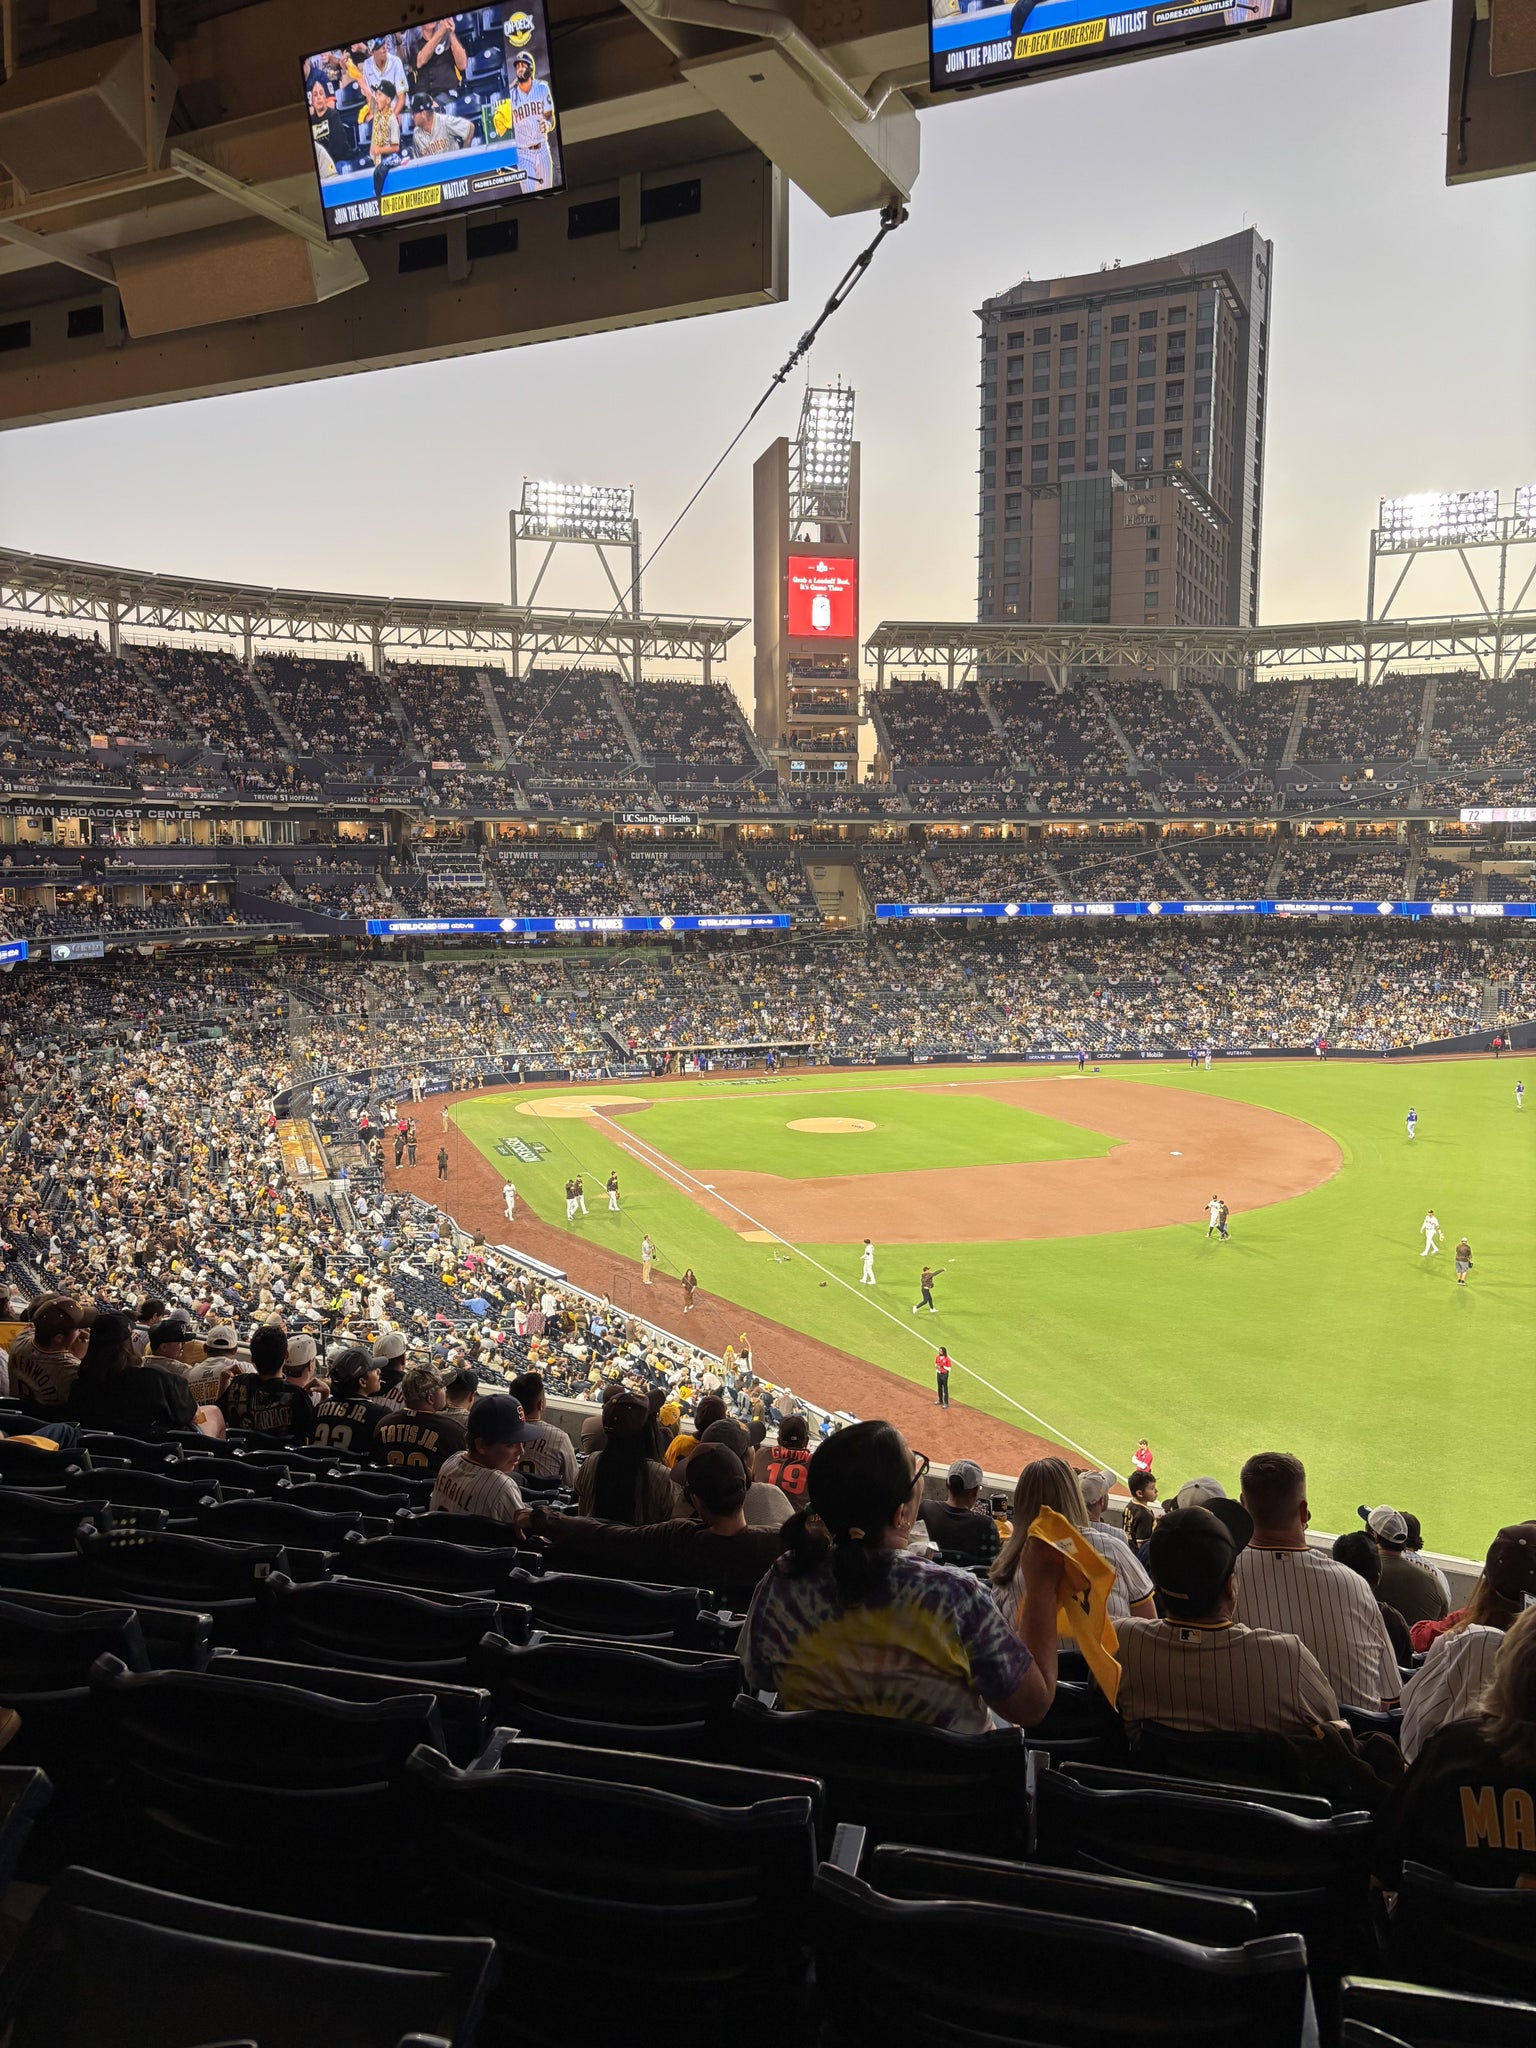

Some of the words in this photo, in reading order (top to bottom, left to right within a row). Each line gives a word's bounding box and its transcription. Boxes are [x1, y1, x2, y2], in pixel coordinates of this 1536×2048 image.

[504, 15, 534, 35] ON-DECK
[1108, 11, 1148, 38] WAITLIST
[1017, 32, 1050, 57] ON-DECK
[1051, 22, 1104, 50] MEMBERSHIP
[945, 52, 965, 73] JOIN
[966, 47, 981, 69] THE
[982, 41, 1012, 66] PADRES
[405, 190, 440, 209] MEMBERSHIP
[442, 180, 469, 200] WAITLIST
[334, 207, 348, 225] JOIN
[347, 205, 360, 223] THE
[359, 201, 380, 219] PADRES
[166, 791, 187, 799] RANDY
[199, 792, 219, 800] JONES
[60, 808, 142, 818] BROADCAST
[147, 809, 201, 819] CENTER
[622, 813, 634, 823] UC
[634, 813, 648, 823] San
[648, 814, 668, 824] Diego
[668, 814, 691, 823] Health
[499, 851, 539, 859] CUTWATER
[631, 852, 668, 860] CUTWATER
[1052, 904, 1072, 914] CUBS
[1086, 904, 1114, 914] PADRES
[1431, 904, 1454, 915] CUBS
[1470, 904, 1504, 915] PADRES
[555, 919, 576, 930] CUBS
[592, 918, 623, 930] PADRES
[316, 1401, 349, 1419] TATIS
[347, 1403, 368, 1424] JR.
[380, 1424, 419, 1444] TATIS
[418, 1428, 439, 1453] JR.
[767, 1462, 808, 1495] 19
[436, 1475, 473, 1511] ERRILL
[1459, 1786, 1536, 1851] MA
